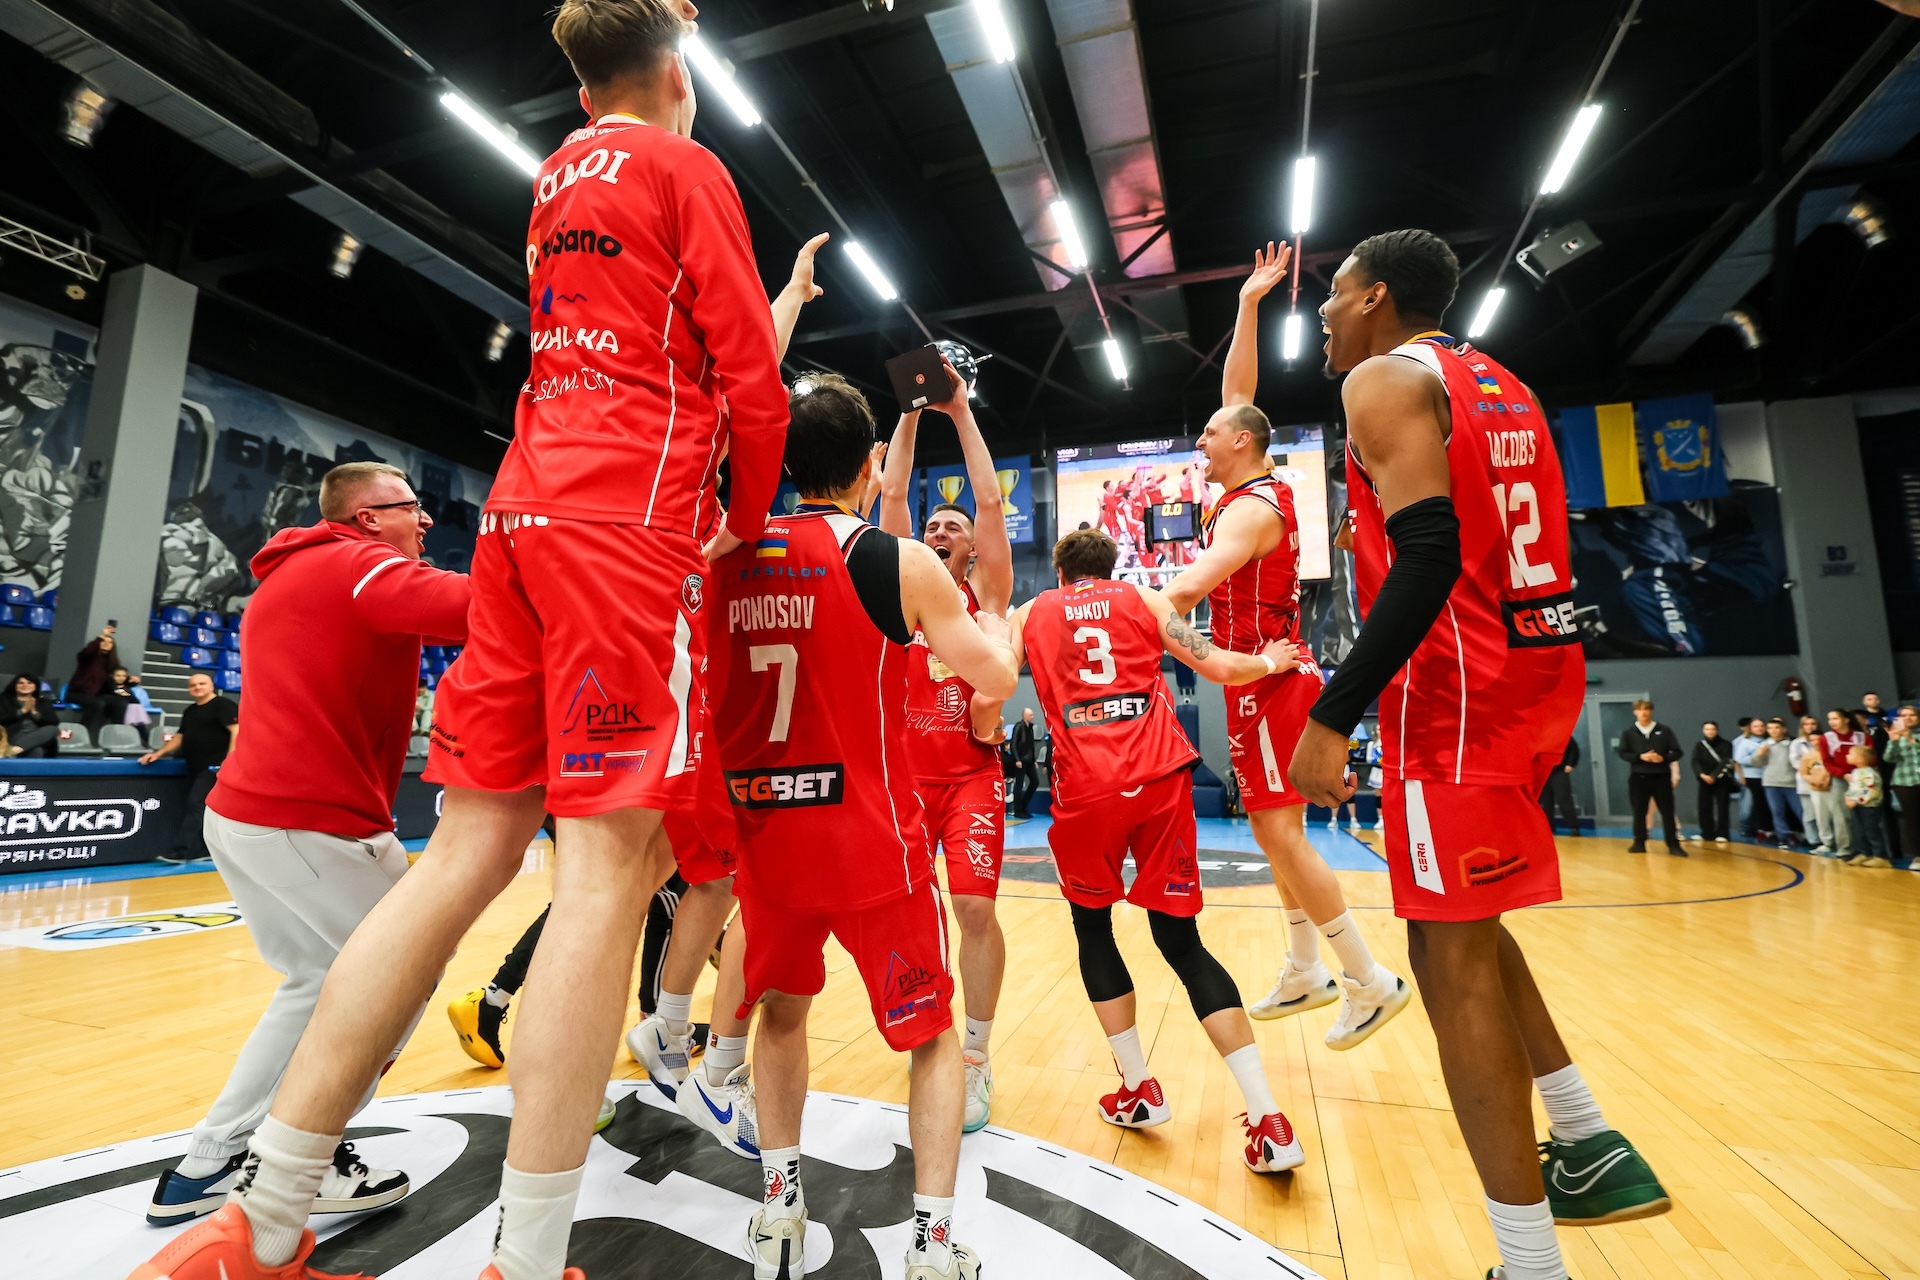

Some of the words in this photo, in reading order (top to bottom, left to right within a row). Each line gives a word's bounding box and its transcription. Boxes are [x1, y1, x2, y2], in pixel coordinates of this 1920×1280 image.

[1161, 503, 1182, 516] 0.0
[740, 565, 827, 579] EPSILON
[1064, 587, 1123, 601] EPSILON
[728, 594, 815, 634] PONOSOV
[1064, 599, 1110, 622] BYKOV
[1073, 626, 1118, 685] 3
[749, 644, 799, 743] 7
[587, 703, 642, 726] РДК
[1238, 694, 1258, 718] 15
[0, 809, 124, 835] AVKA
[969, 827, 996, 836] imtrex
[1178, 856, 1194, 869] РД
[1416, 843, 1428, 872] GERA
